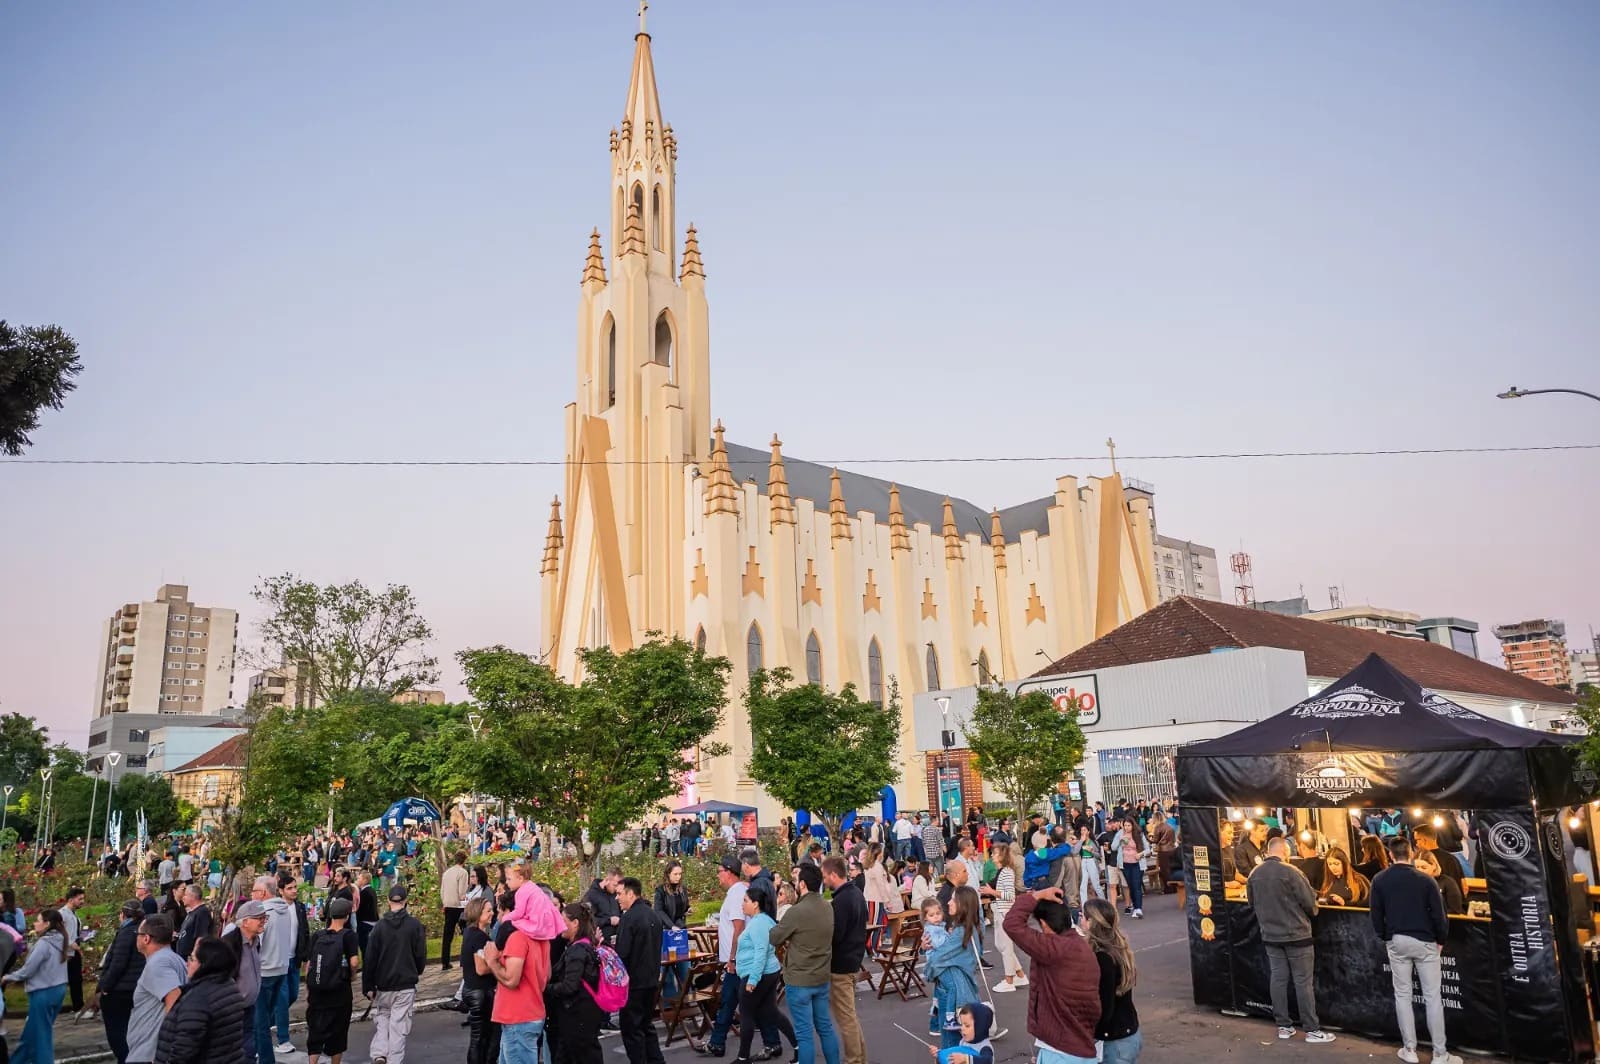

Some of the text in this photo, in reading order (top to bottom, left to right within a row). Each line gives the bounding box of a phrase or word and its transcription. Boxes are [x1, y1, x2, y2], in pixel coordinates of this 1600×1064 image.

[1290, 701, 1401, 716] LEOPOLDINA
[1296, 777, 1372, 788] LEOPOLDINA
[1521, 896, 1544, 949] HISTÓRIA
[1440, 957, 1456, 966] NDOS
[1509, 933, 1529, 983] É OUTRA
[1441, 971, 1460, 980] VEJA
[1441, 985, 1462, 995] TRAM,
[1441, 998, 1464, 1009] TÓRIA.
